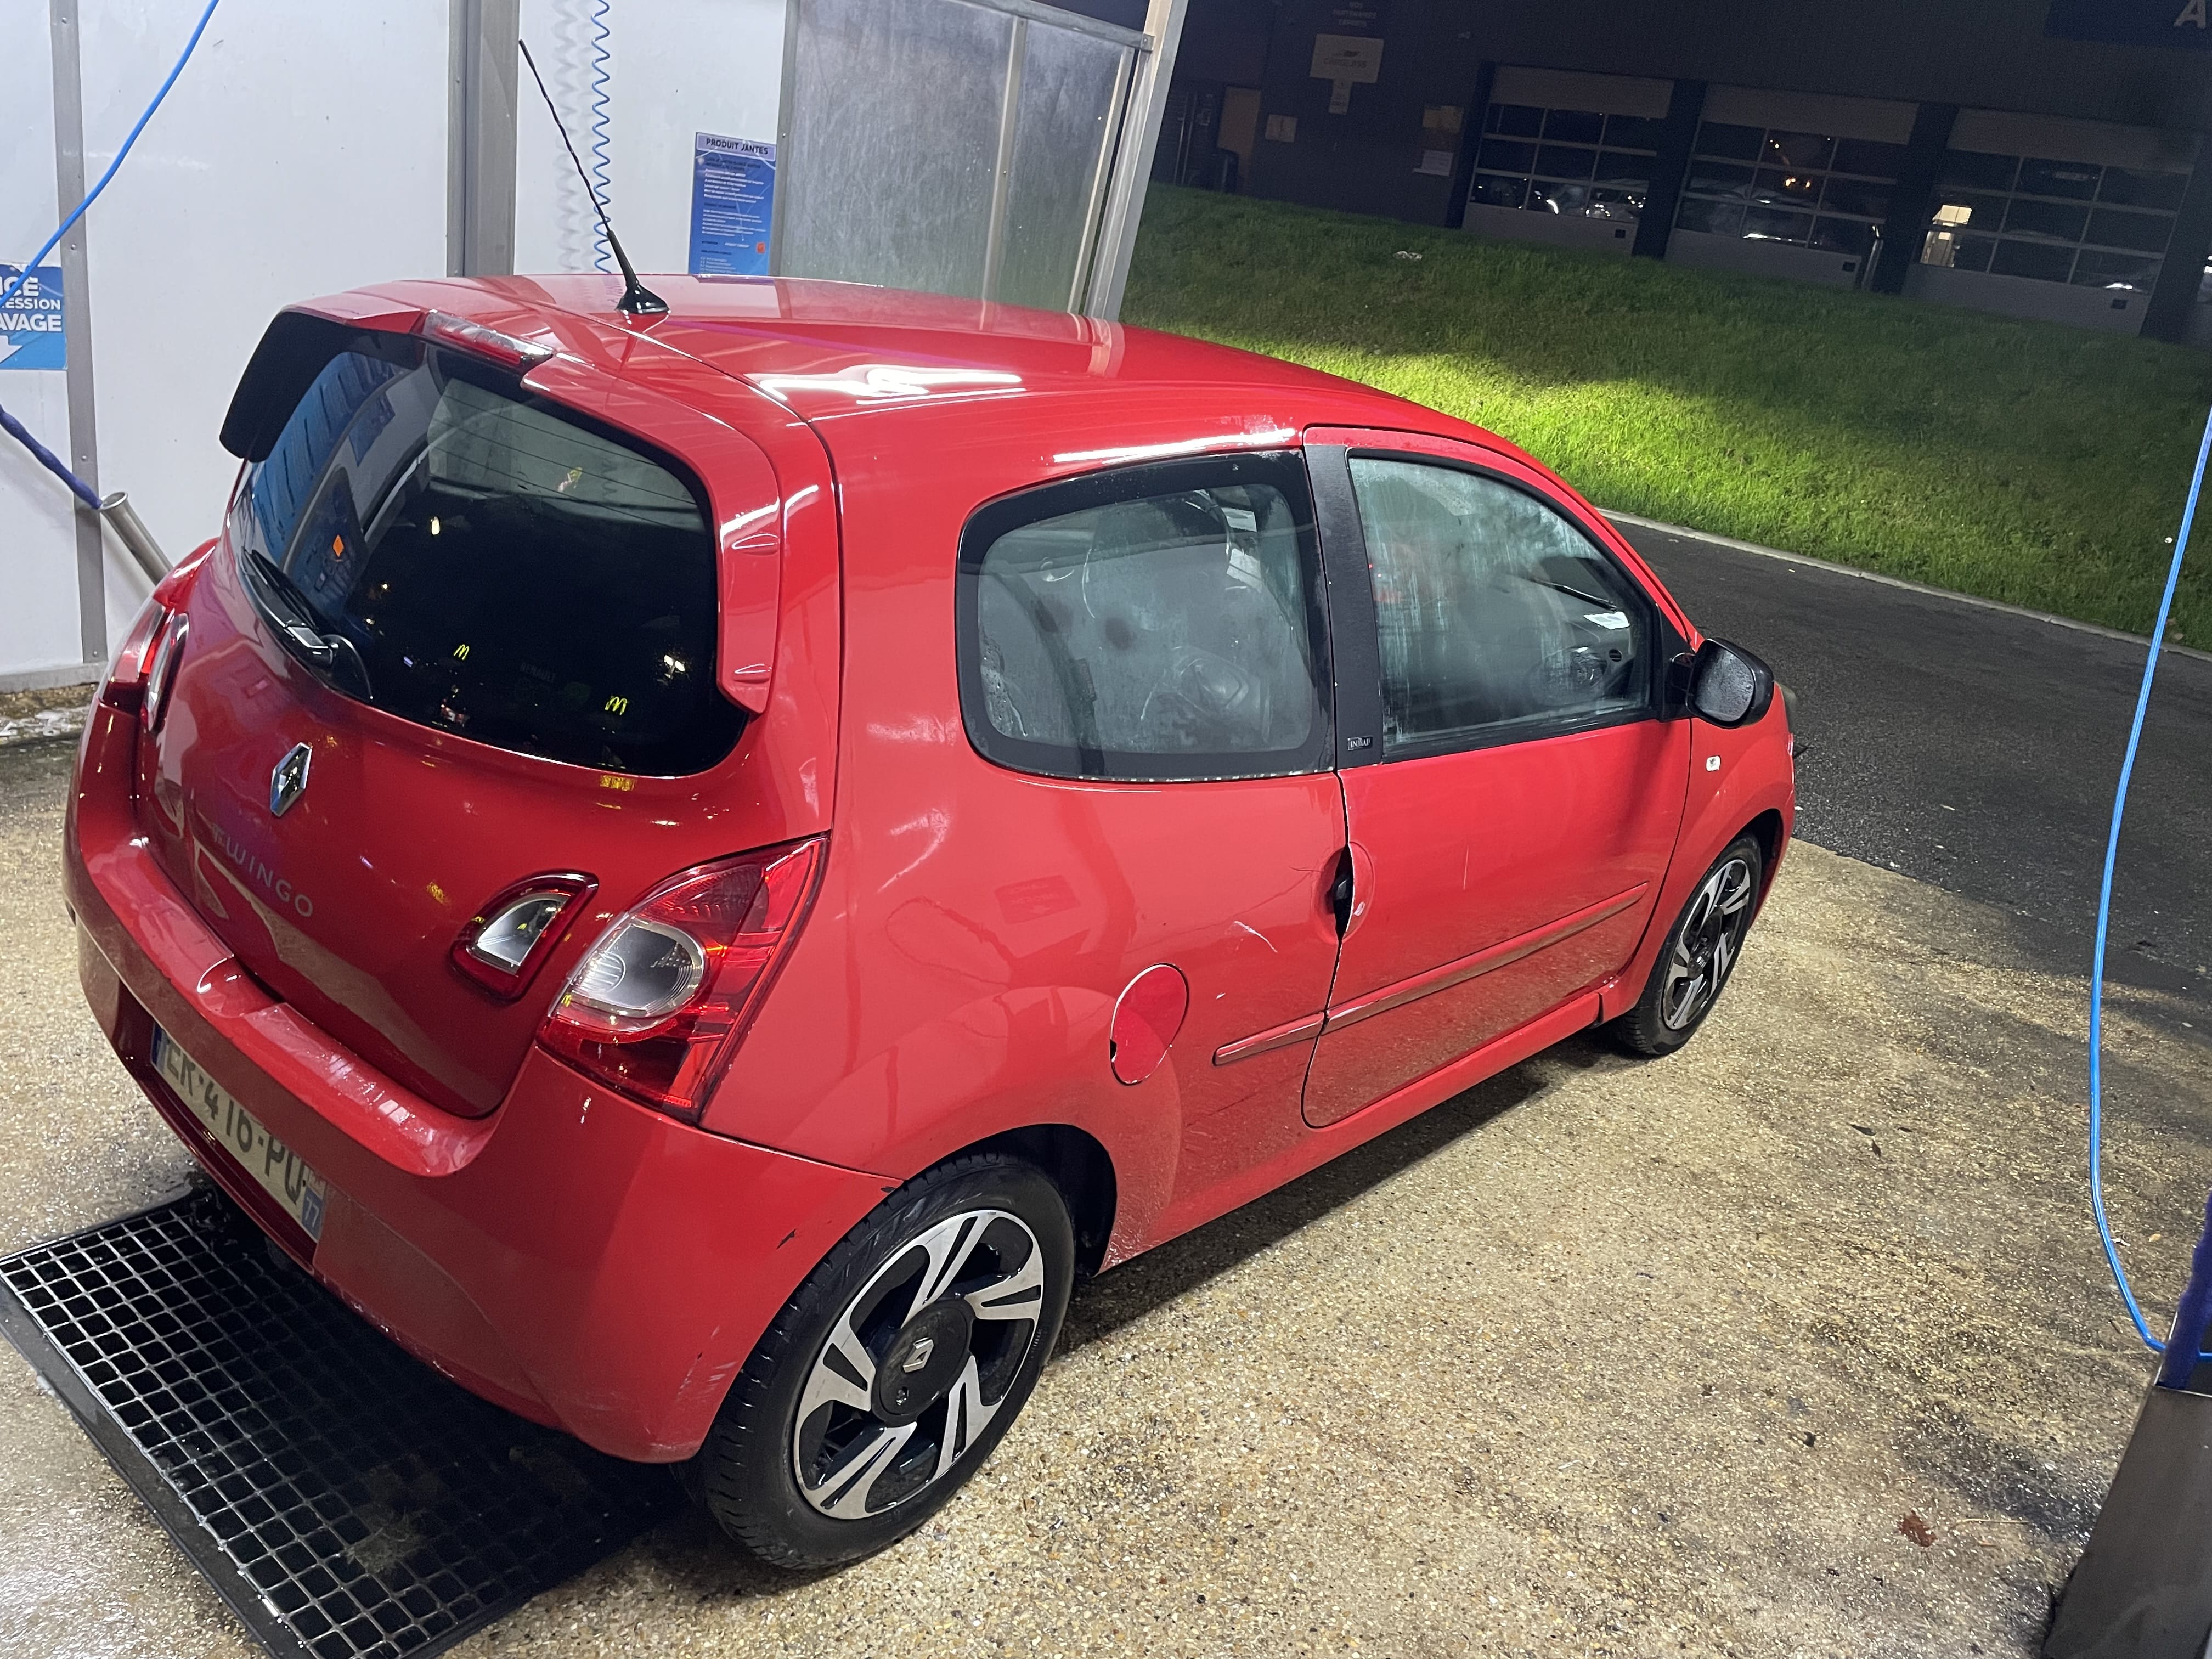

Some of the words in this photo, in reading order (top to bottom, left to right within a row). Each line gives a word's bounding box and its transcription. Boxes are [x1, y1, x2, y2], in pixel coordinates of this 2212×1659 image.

[706, 138, 739, 150] PRODUIT
[741, 144, 769, 155] JANTES
[0, 276, 40, 297] CE
[2, 298, 61, 311] ESSION
[212, 823, 313, 917] TWINGO
[305, 1198, 319, 1230] 77
